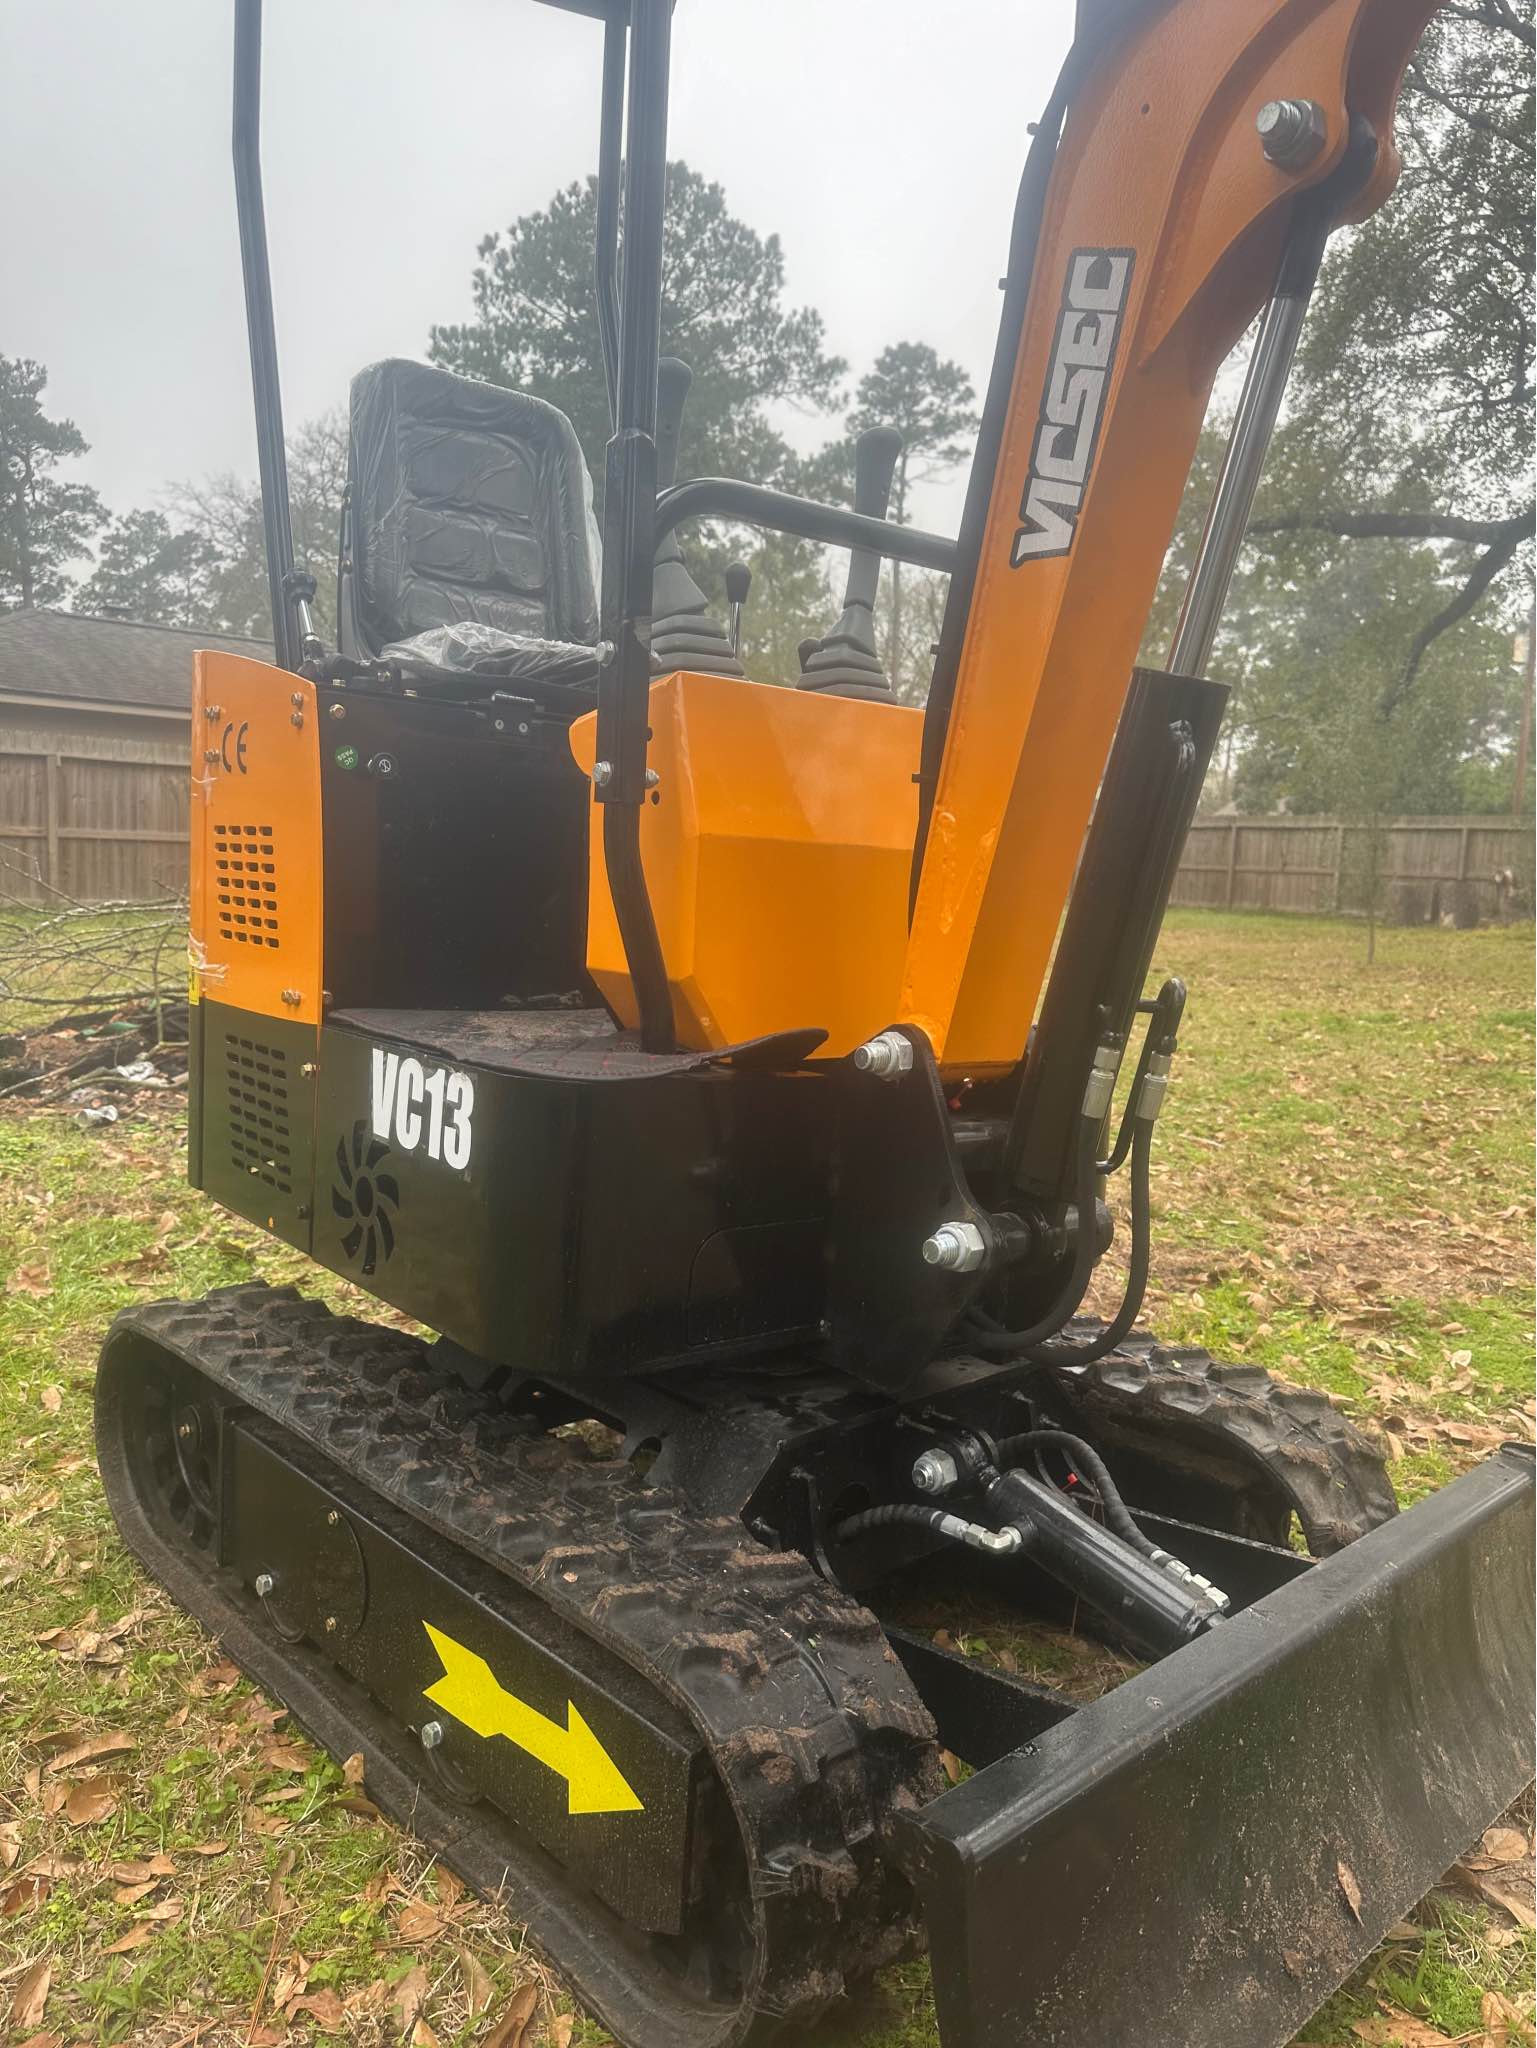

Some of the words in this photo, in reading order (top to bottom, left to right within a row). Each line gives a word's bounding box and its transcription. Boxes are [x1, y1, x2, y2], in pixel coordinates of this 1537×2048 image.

[1014, 253, 1130, 562] VICSEC
[221, 721, 249, 774] CE
[372, 1047, 475, 1170] VC13
